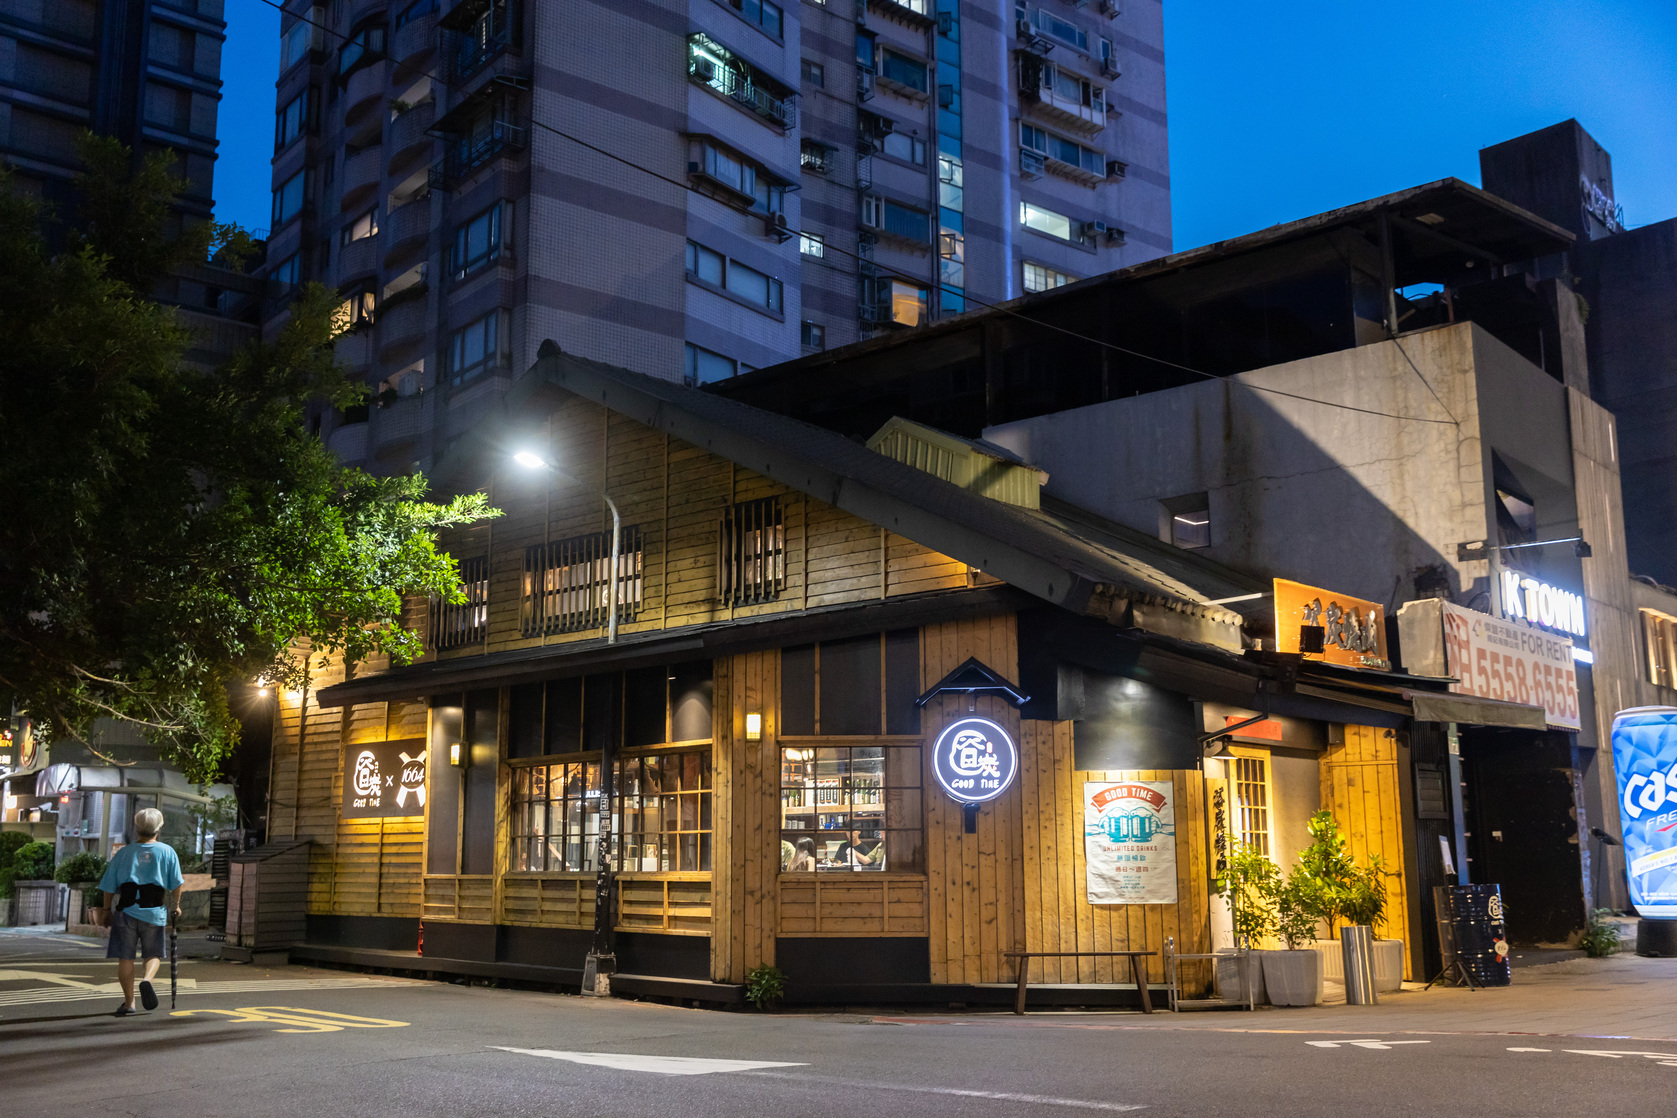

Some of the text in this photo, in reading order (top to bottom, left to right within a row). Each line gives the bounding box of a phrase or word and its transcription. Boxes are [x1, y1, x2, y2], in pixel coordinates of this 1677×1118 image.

[1505, 570, 1585, 636] K TOWN
[1521, 632, 1544, 657] FOR
[1546, 640, 1572, 664] RENT
[401, 765, 425, 783] 1664
[951, 778, 1000, 789] GOOD TIME
[1104, 787, 1154, 801] GOOD TIME
